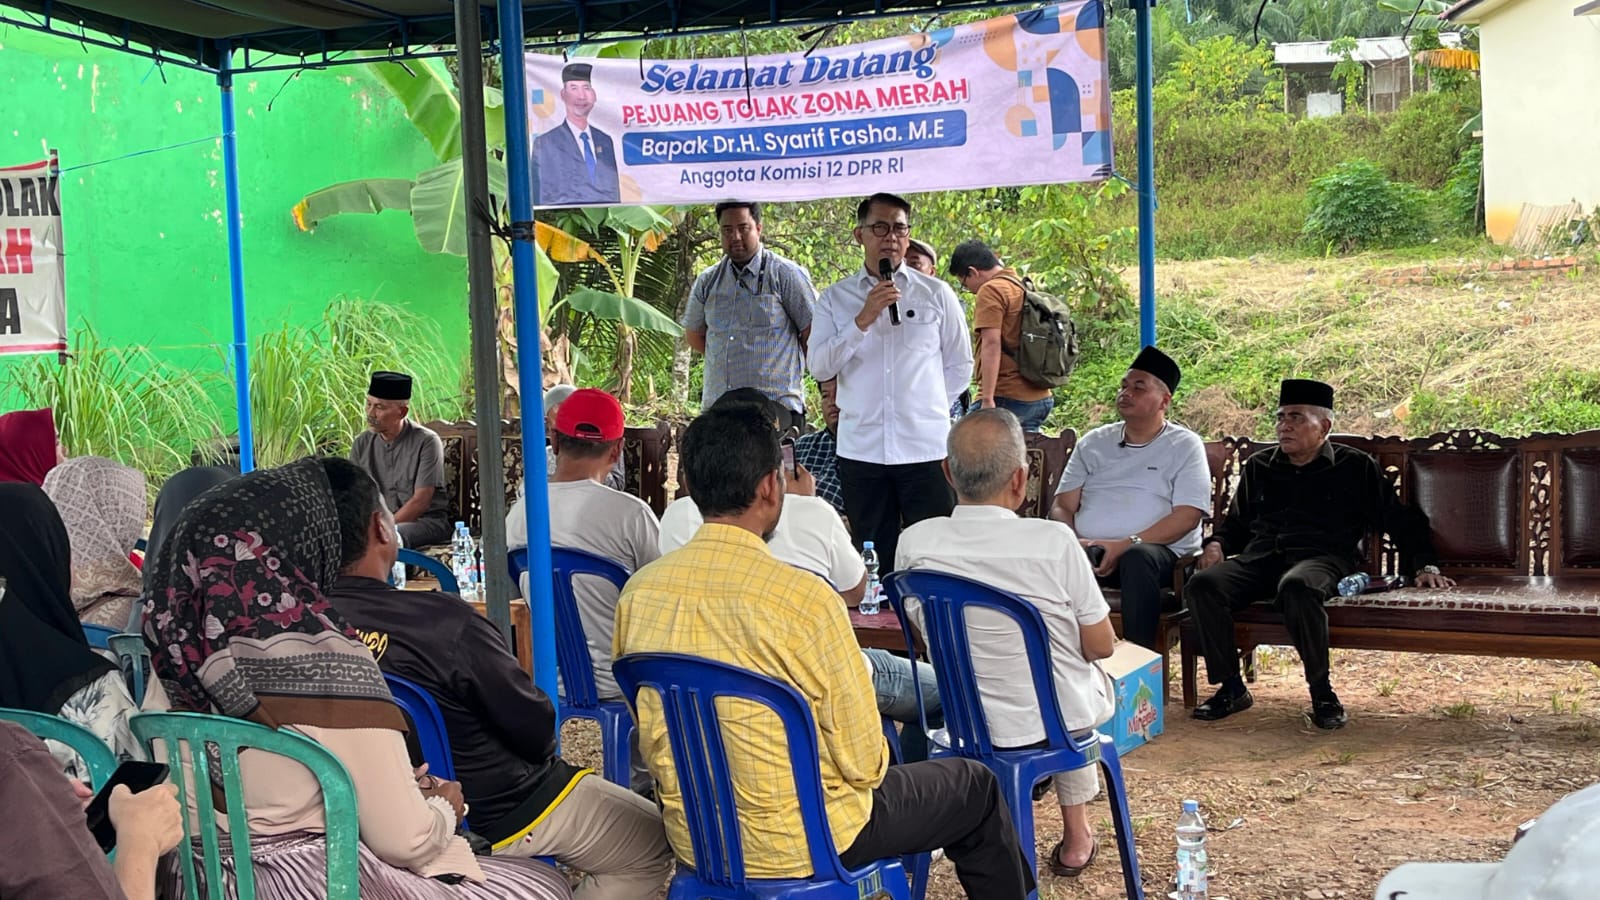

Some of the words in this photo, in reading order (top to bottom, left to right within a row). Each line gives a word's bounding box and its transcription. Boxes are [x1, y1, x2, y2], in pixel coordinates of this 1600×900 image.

[640, 62, 793, 93] Selamat
[800, 46, 936, 83] Datang
[622, 101, 719, 125] PEJUANG
[722, 95, 799, 121] TOLAK
[805, 88, 872, 114] ZONA
[877, 78, 968, 107] MERAH
[642, 136, 708, 161] Bapak
[713, 133, 761, 154] Dr.H.
[766, 124, 824, 155] Syarif
[830, 123, 903, 146] Fasha.
[908, 118, 945, 141] M.E
[680, 166, 756, 189] Anggota
[760, 160, 821, 181] Komisi
[826, 160, 844, 178] 12
[847, 158, 883, 177] DPR
[888, 156, 905, 174] RI
[0, 176, 61, 216] LAK
[0, 228, 33, 274] H
